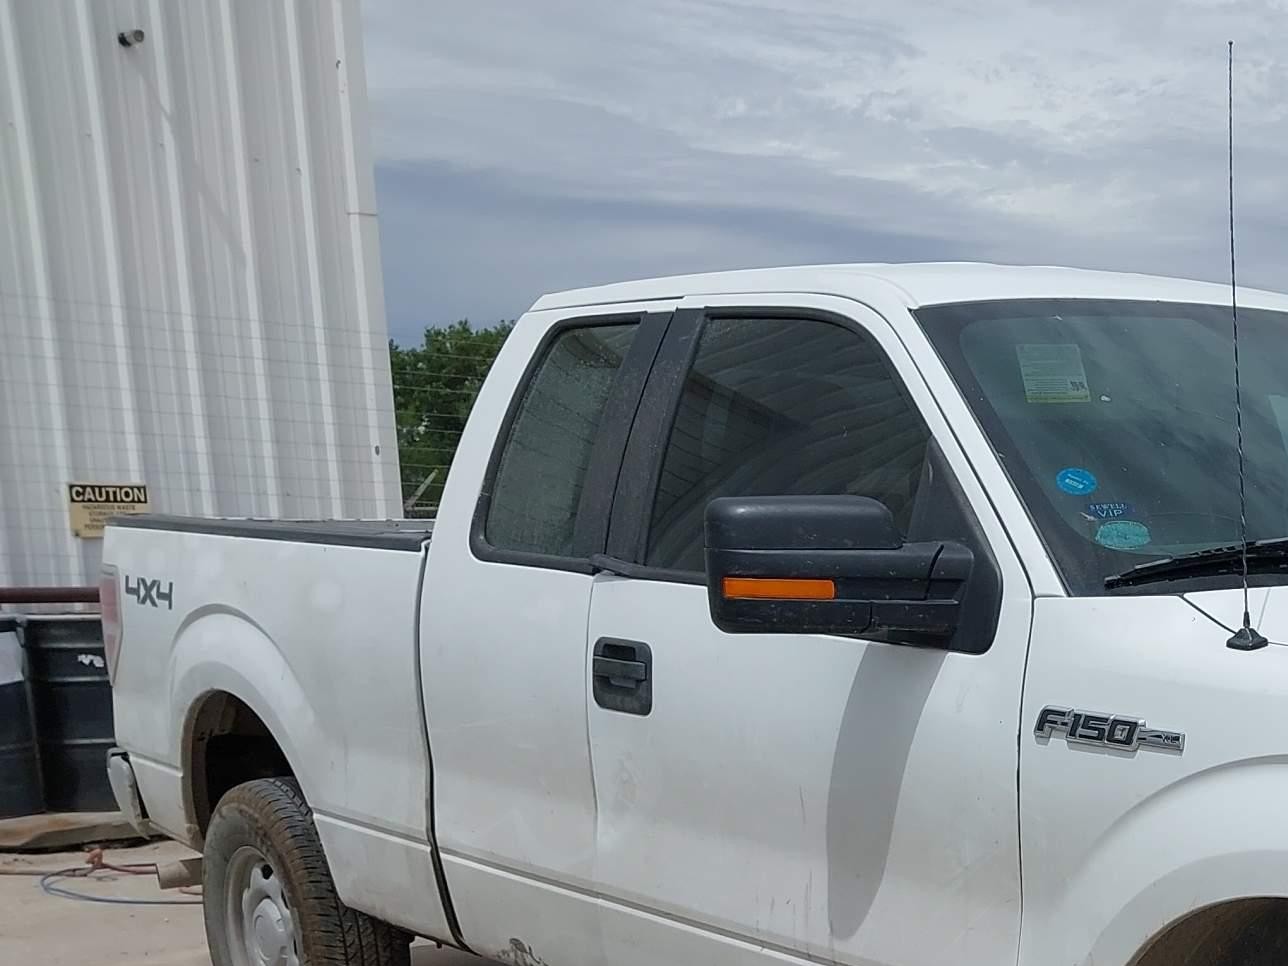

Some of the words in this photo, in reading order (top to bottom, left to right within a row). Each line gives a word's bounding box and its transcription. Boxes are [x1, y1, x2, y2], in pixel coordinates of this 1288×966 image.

[71, 486, 146, 502] CAUTION
[1097, 509, 1123, 518] VIP
[125, 574, 173, 610] 4X4
[1034, 705, 1143, 752] F-150
